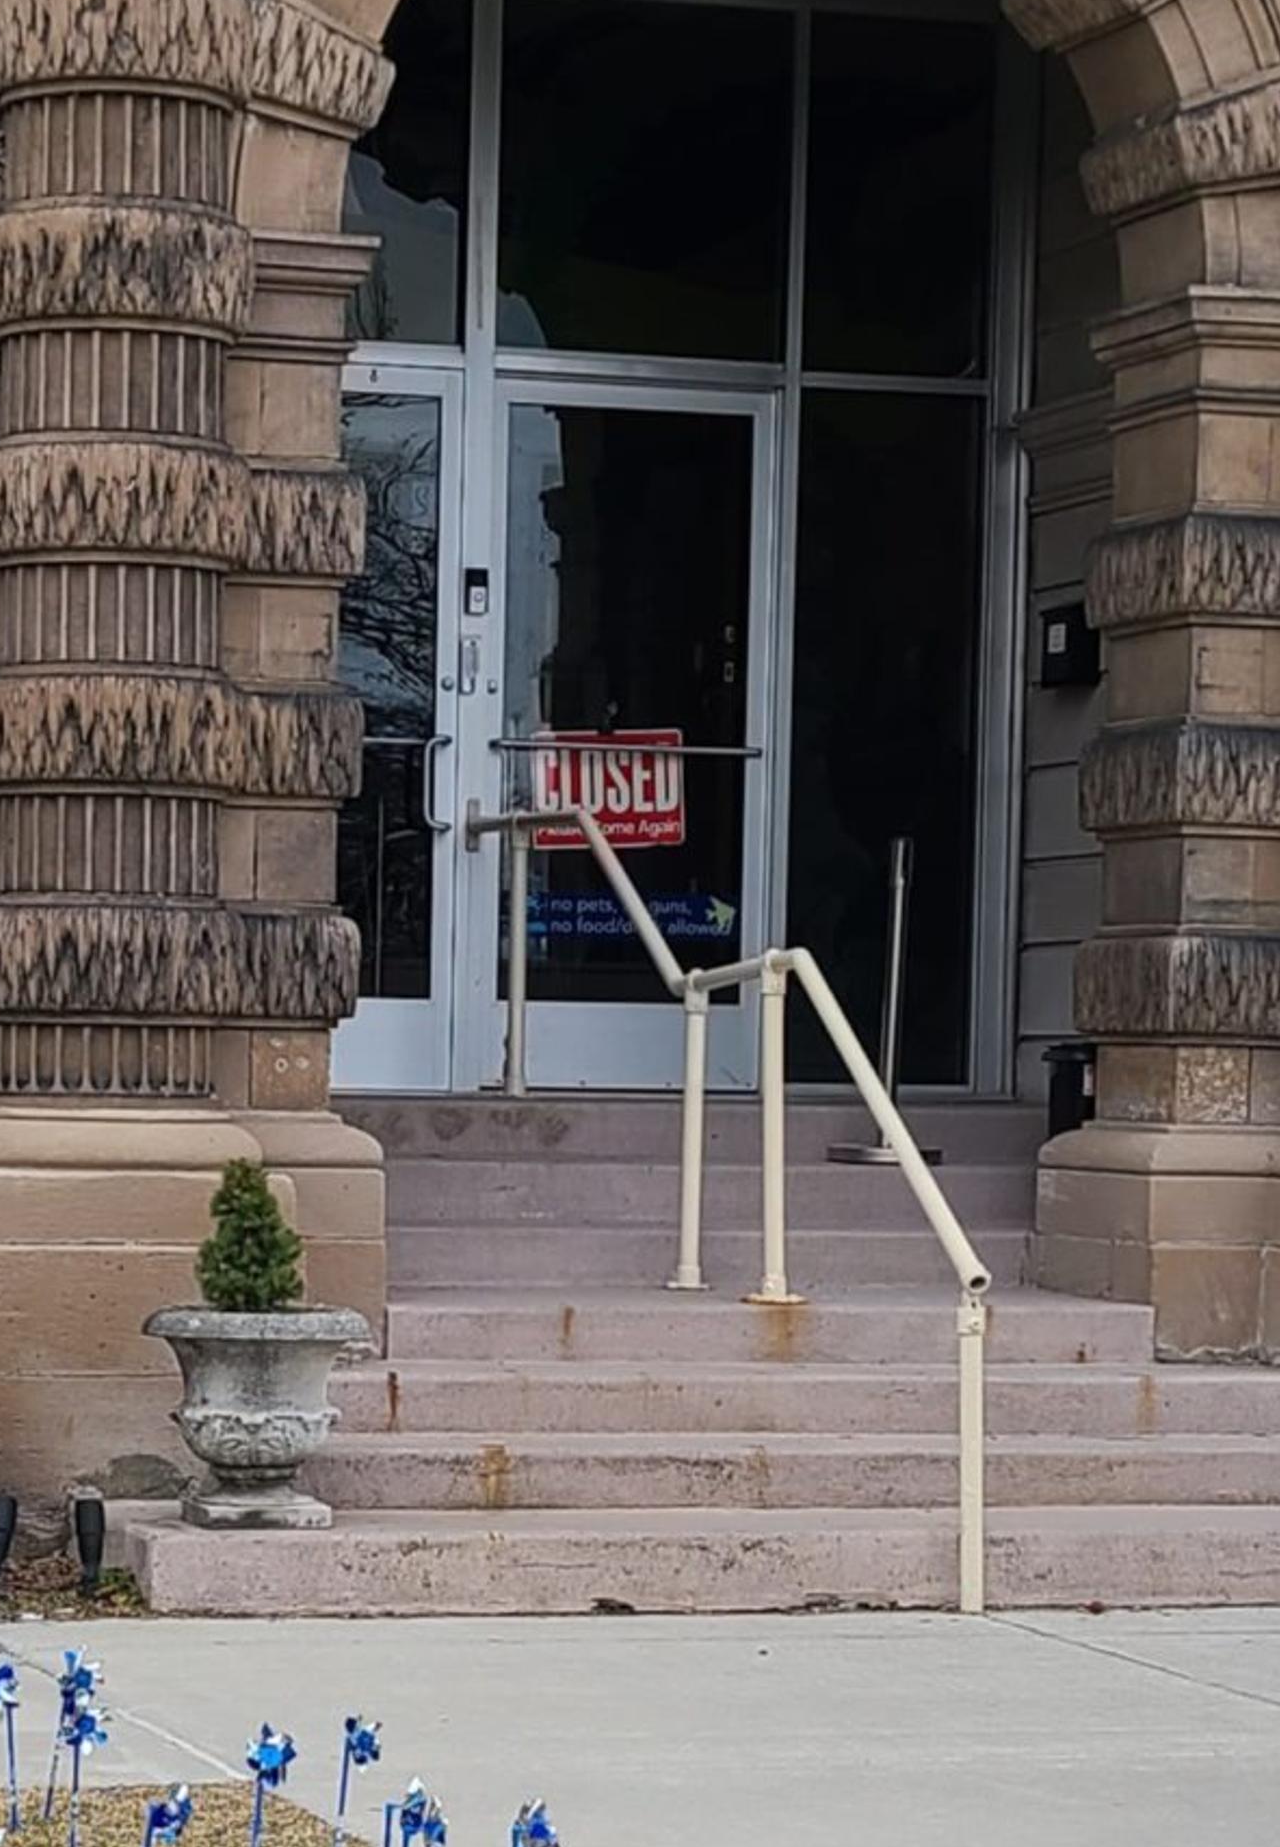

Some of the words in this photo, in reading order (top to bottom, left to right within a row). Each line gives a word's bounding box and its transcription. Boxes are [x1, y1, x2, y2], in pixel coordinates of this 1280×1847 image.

[535, 744, 680, 815] CLOSED
[598, 821, 635, 835] ome
[638, 818, 679, 839] Again
[550, 898, 571, 911] no
[577, 897, 618, 915] pets,
[550, 920, 571, 933] no
